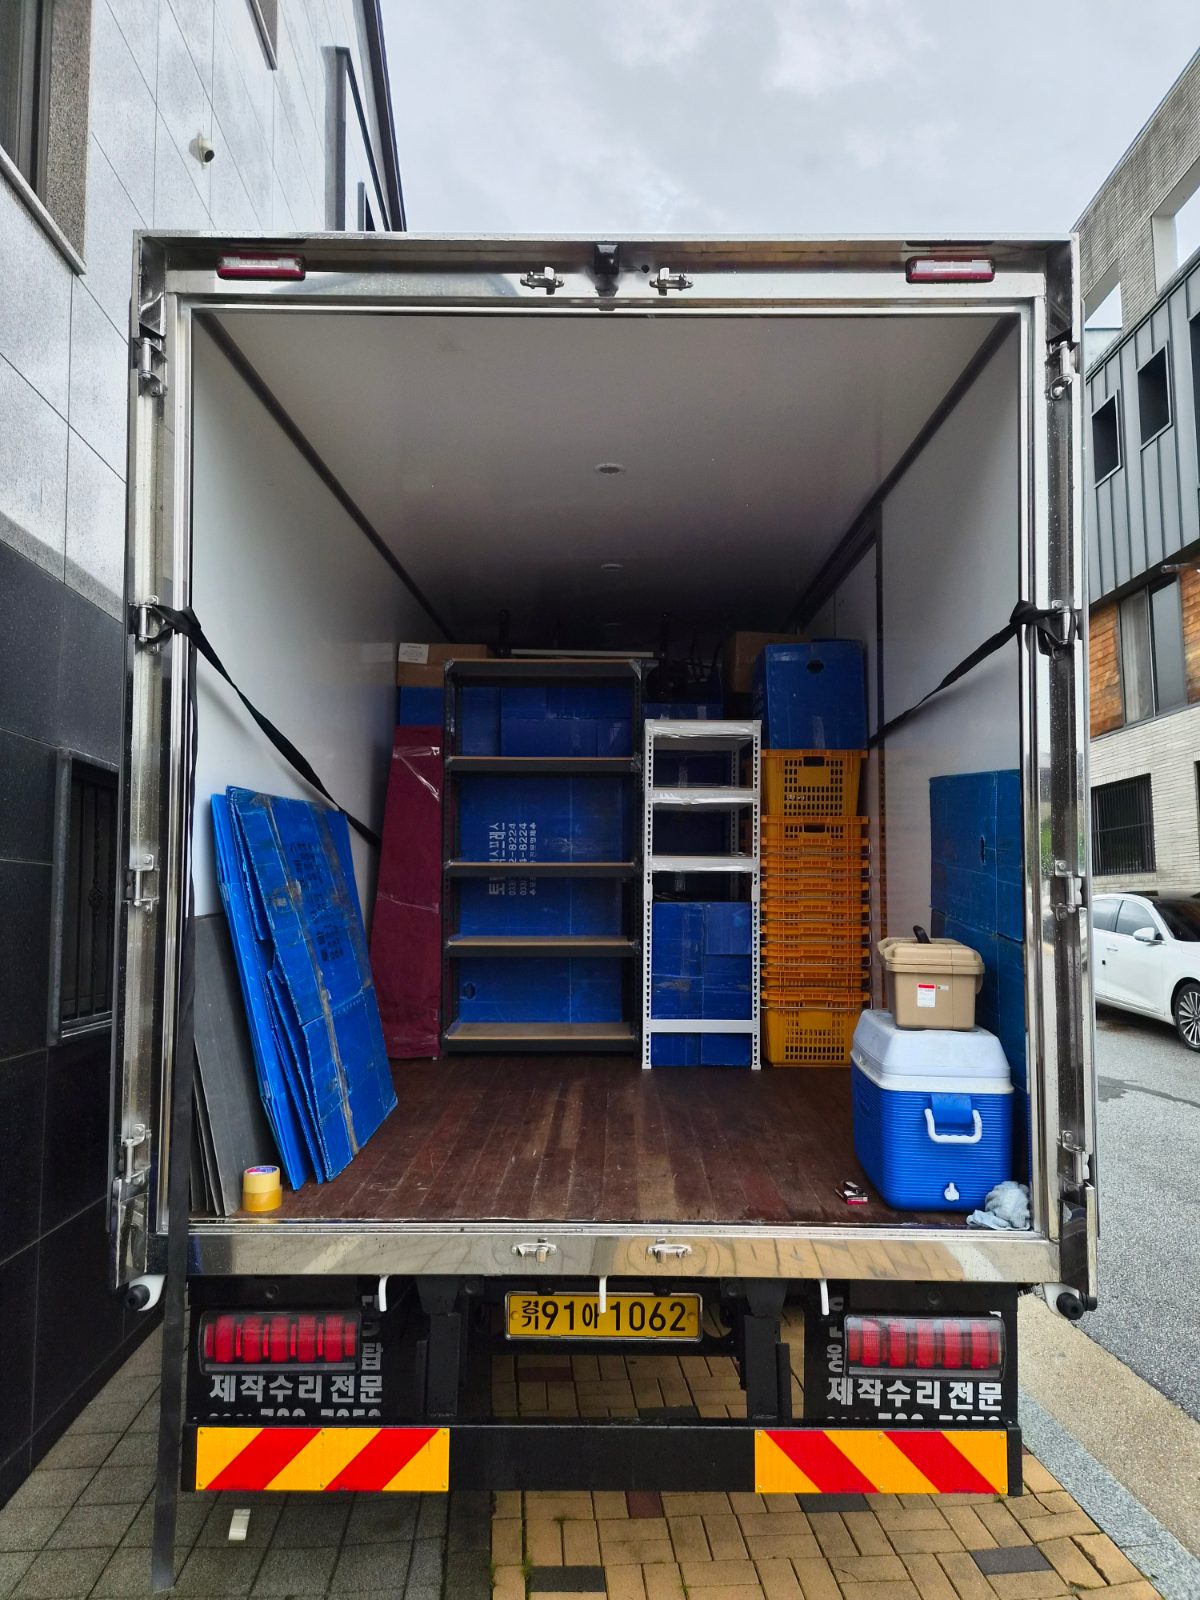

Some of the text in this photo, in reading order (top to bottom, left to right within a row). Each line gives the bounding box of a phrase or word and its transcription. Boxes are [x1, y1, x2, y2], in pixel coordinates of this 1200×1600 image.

[610, 1301, 686, 1331] 1062
[209, 1375, 382, 1403] 제작수리 전문
[826, 1377, 1002, 1411] 제작수리 전문
